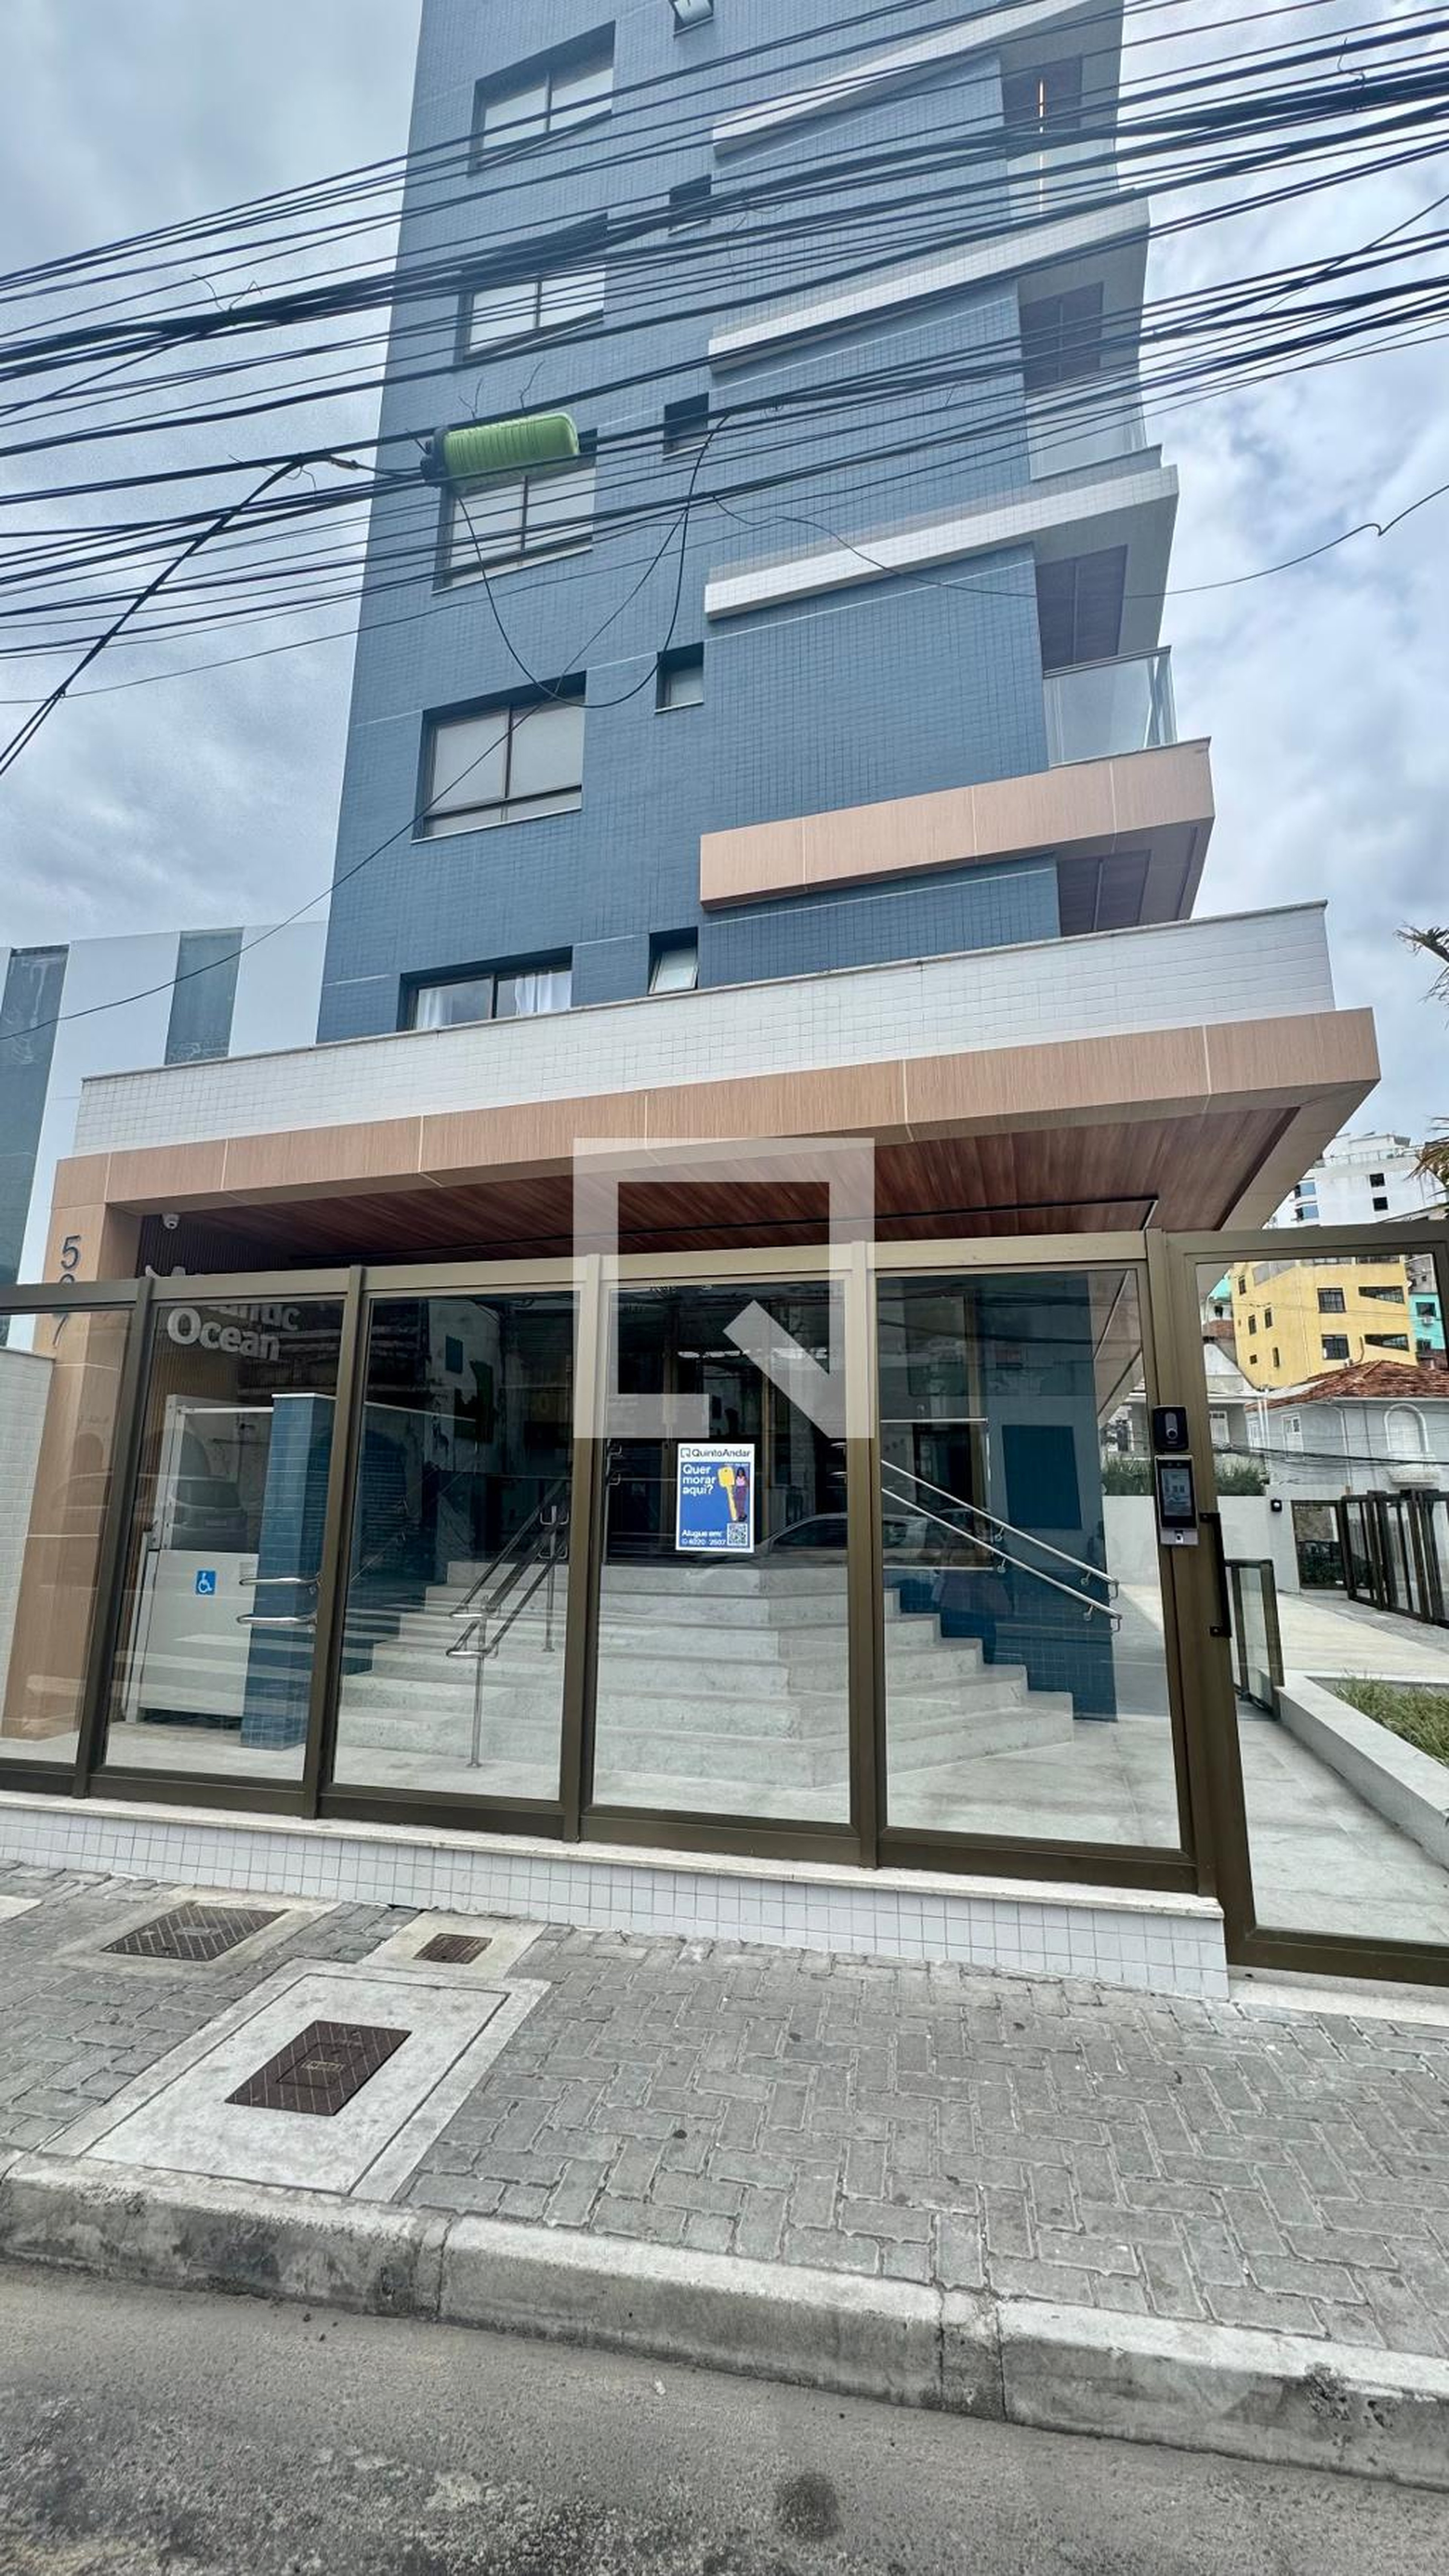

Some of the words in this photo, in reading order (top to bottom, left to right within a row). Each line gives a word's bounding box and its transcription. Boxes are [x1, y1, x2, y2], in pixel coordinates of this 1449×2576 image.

[167, 1307, 281, 1360] Ocean
[692, 1449, 751, 1457] QuintoAndar
[683, 1464, 711, 1474] Quer
[683, 1484, 714, 1496] aqui?
[681, 1530, 708, 1538] Alugue
